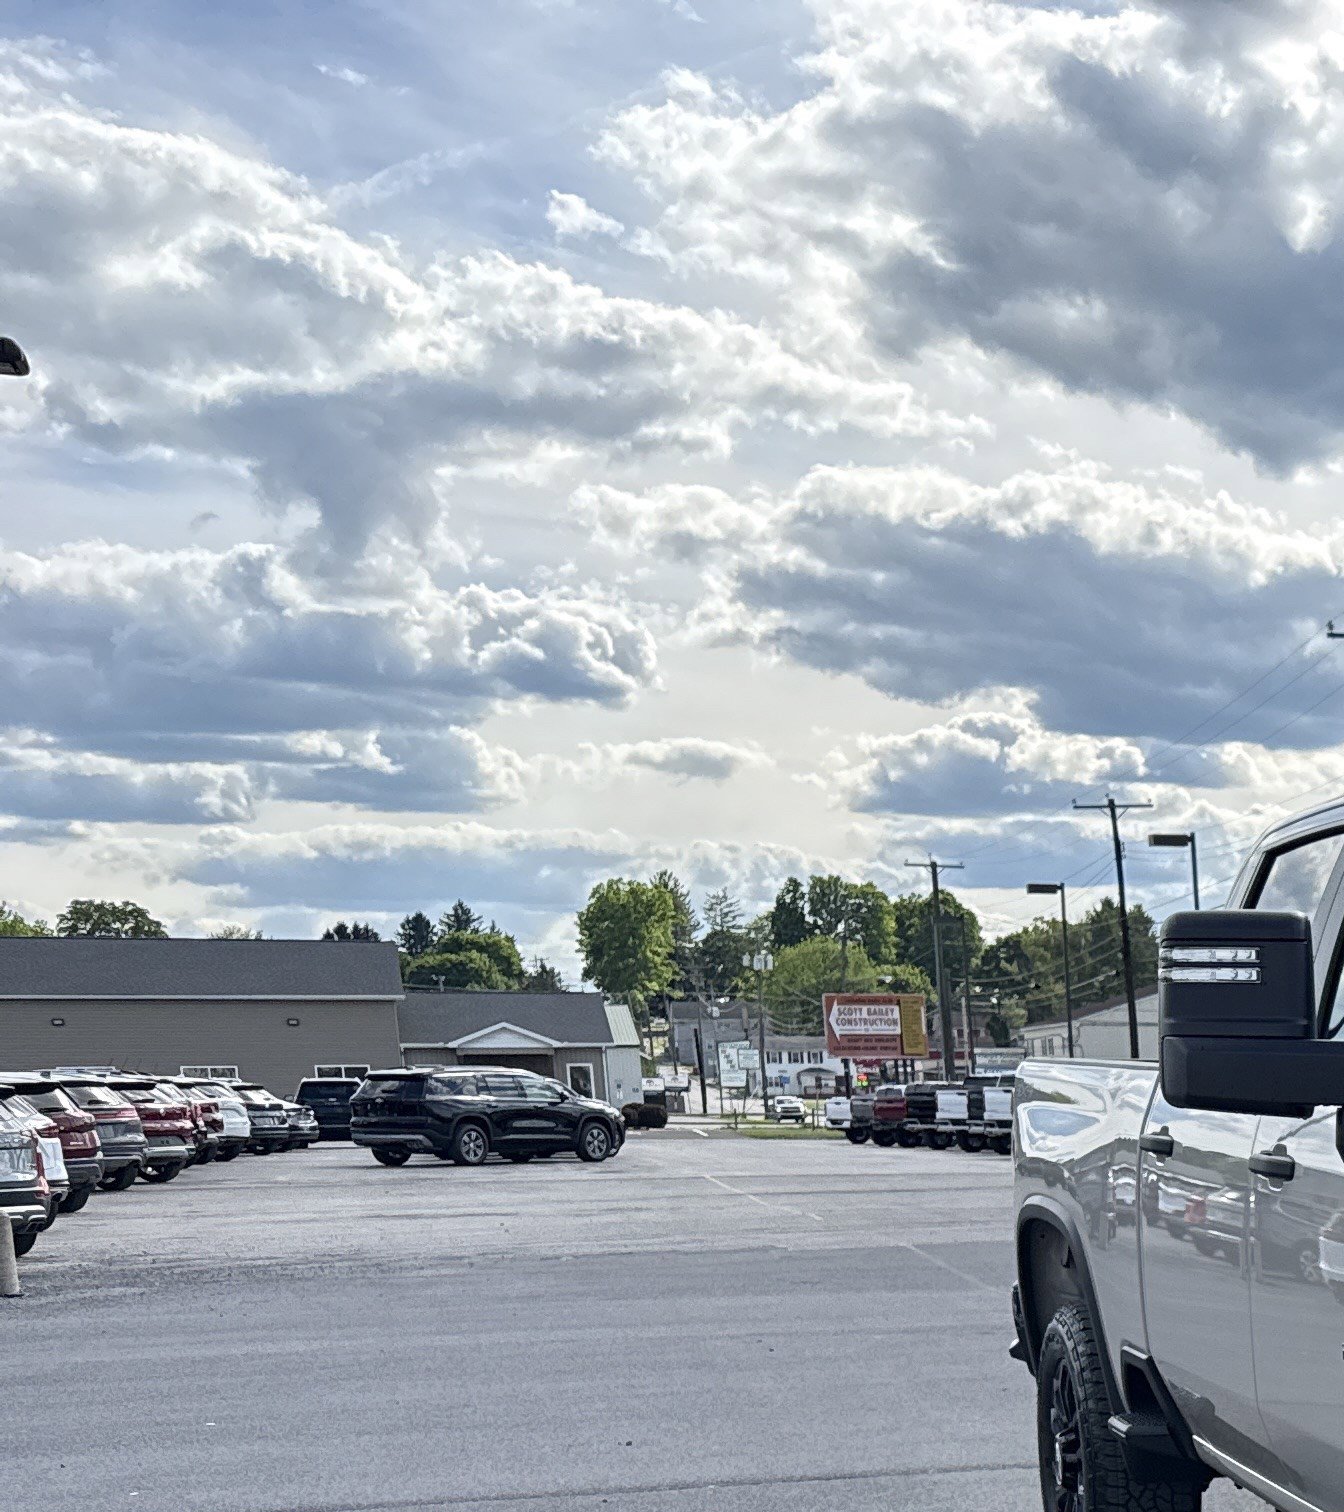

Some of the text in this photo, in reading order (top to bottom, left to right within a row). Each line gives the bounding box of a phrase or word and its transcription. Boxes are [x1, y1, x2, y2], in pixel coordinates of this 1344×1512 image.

[837, 1007, 895, 1017] SCOTT BAILEY
[836, 1017, 899, 1027] CONSTRUCTION
